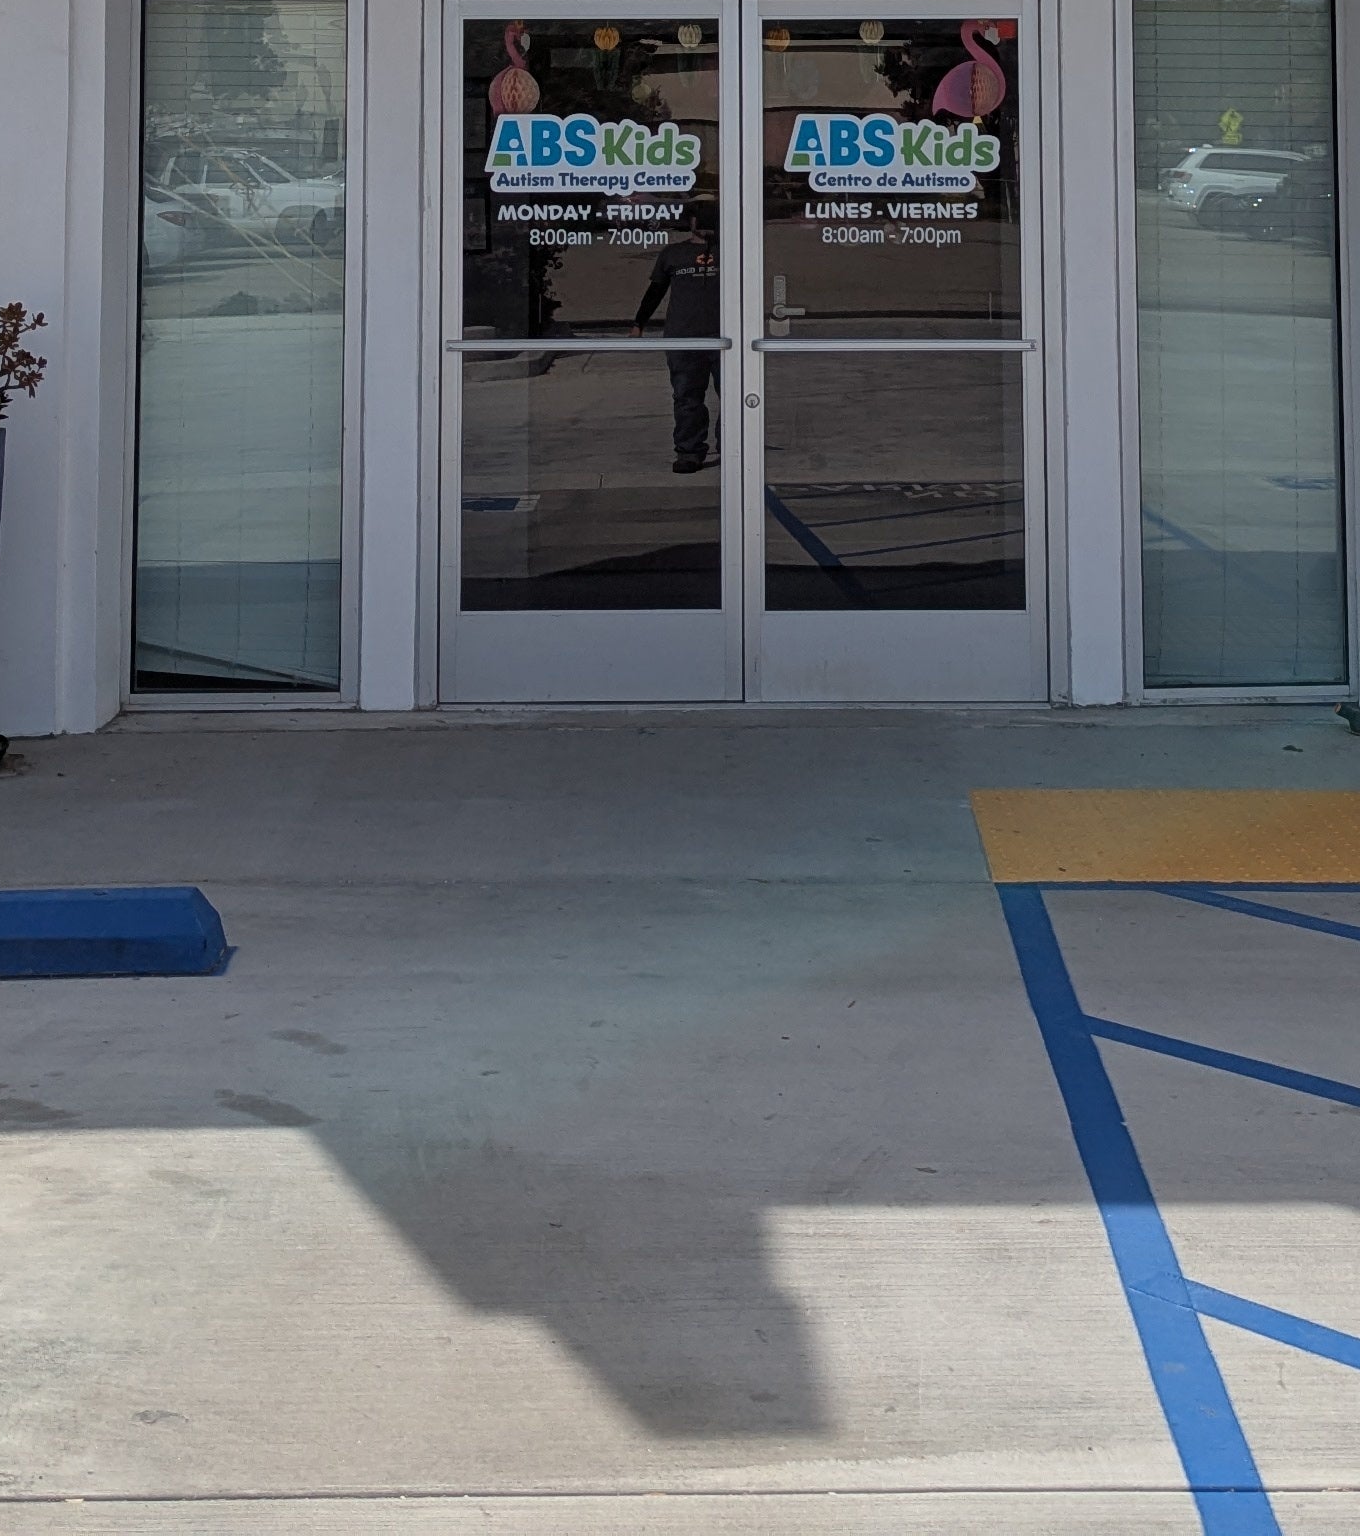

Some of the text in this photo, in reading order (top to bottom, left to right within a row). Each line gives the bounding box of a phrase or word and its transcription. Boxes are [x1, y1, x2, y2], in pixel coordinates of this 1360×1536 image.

[492, 119, 695, 166] ABS Kids
[791, 119, 995, 166] ABS Kids
[496, 171, 690, 190] Autism Therapy Center
[814, 172, 970, 187] Centro de Autismo
[497, 204, 591, 221] MONDAY
[606, 204, 684, 221] FRIDAY
[805, 202, 873, 219] LUNES
[887, 202, 978, 219] VIERNES
[529, 229, 592, 246] 8:00am
[608, 228, 669, 249] 7:00pm
[822, 227, 885, 244] 8:00am
[900, 227, 962, 248] 7:00pm
